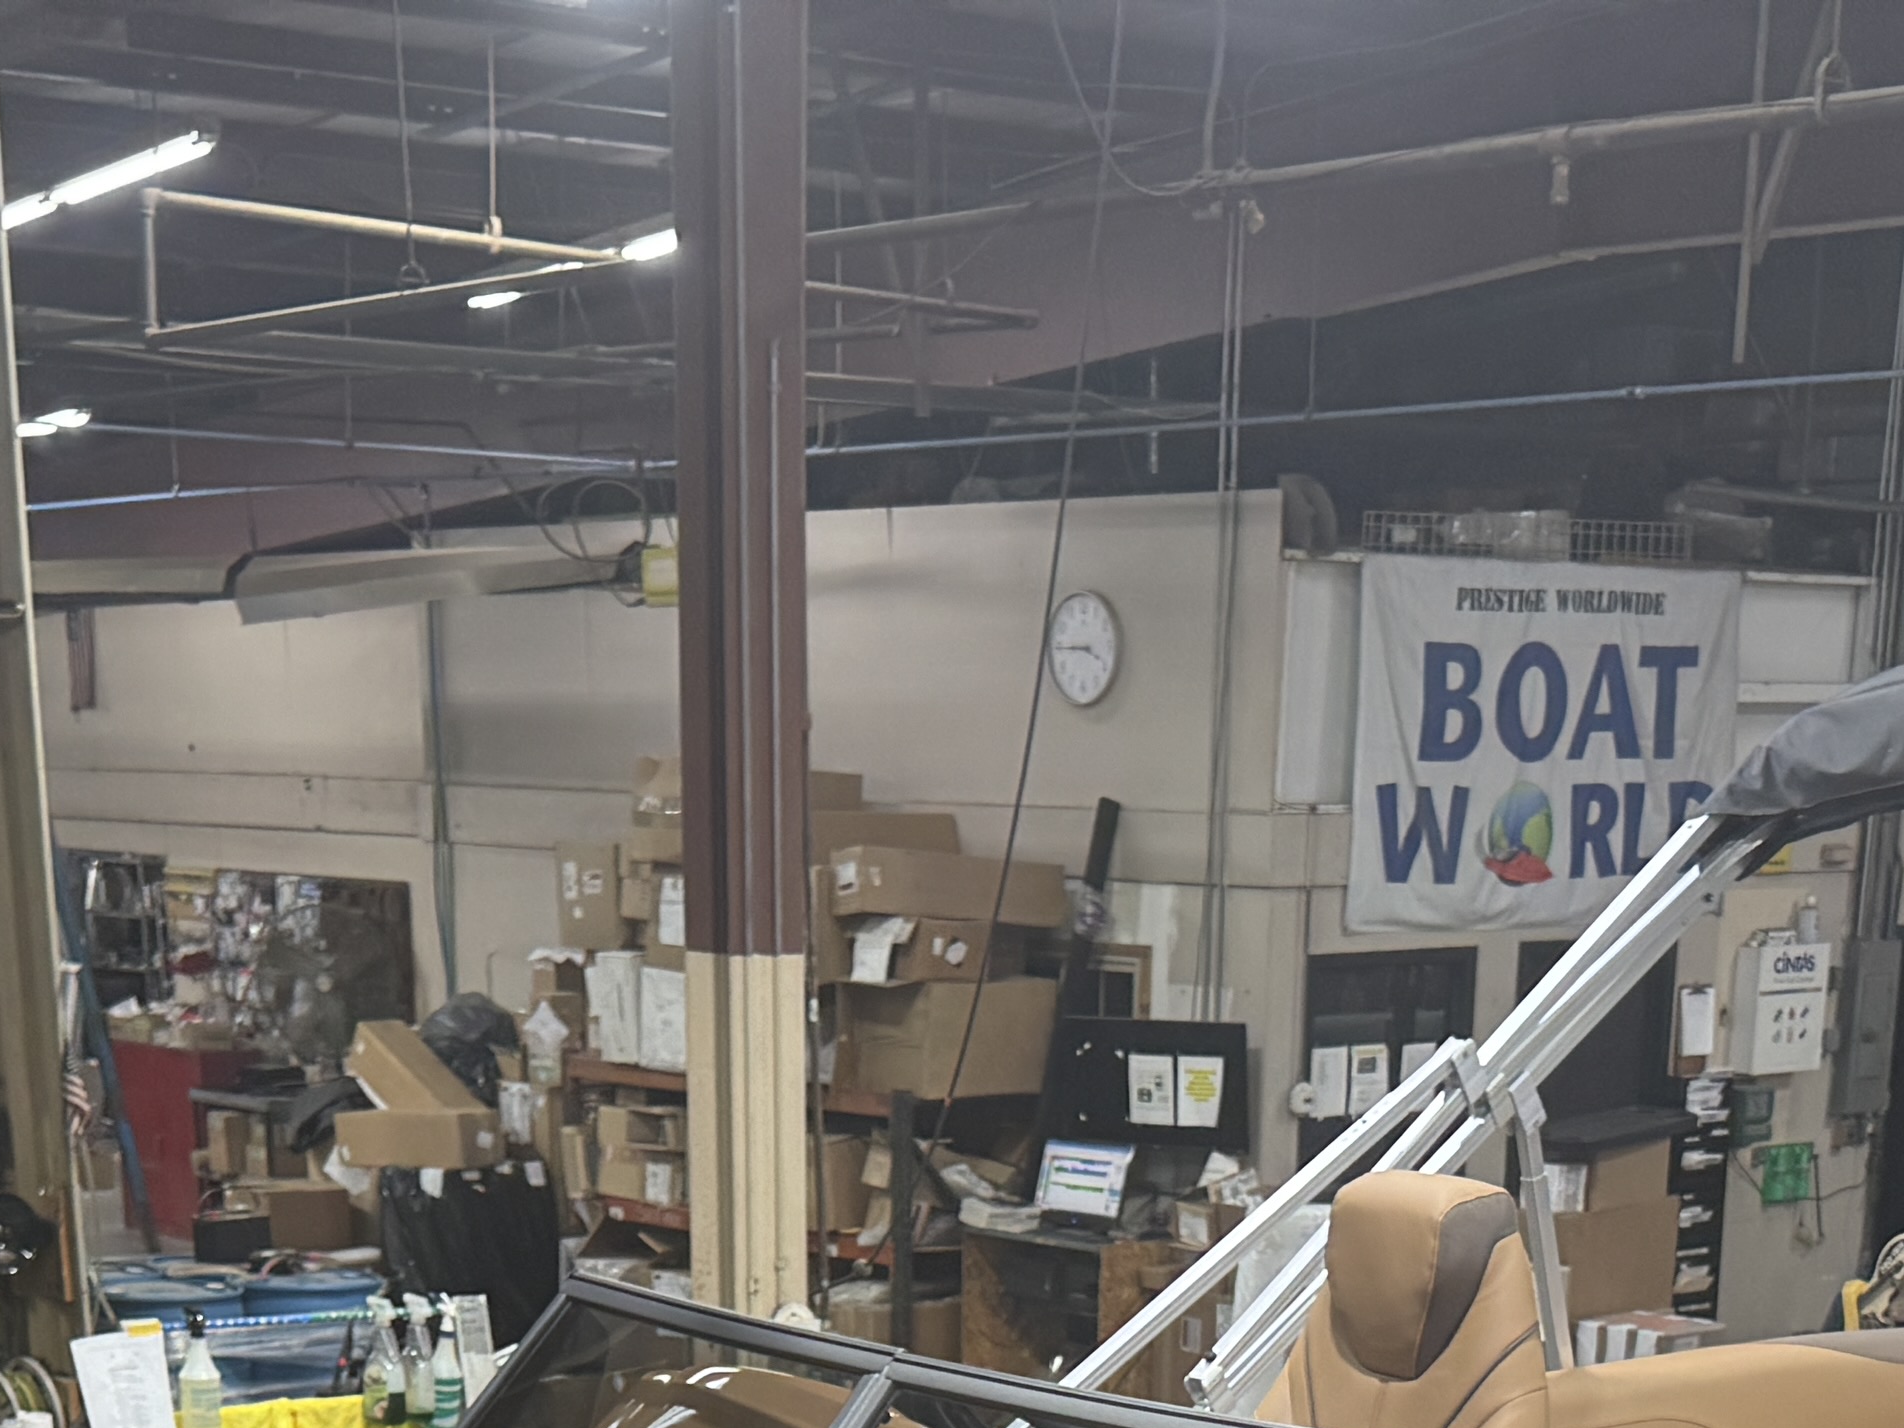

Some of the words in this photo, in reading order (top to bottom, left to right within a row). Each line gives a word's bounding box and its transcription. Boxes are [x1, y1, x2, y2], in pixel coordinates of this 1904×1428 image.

[1455, 586, 1546, 613] PRESTIGE
[1556, 588, 1667, 616] WORLDWIDE
[1417, 641, 1699, 763] BOAT
[1773, 951, 1816, 974] CINTAS
